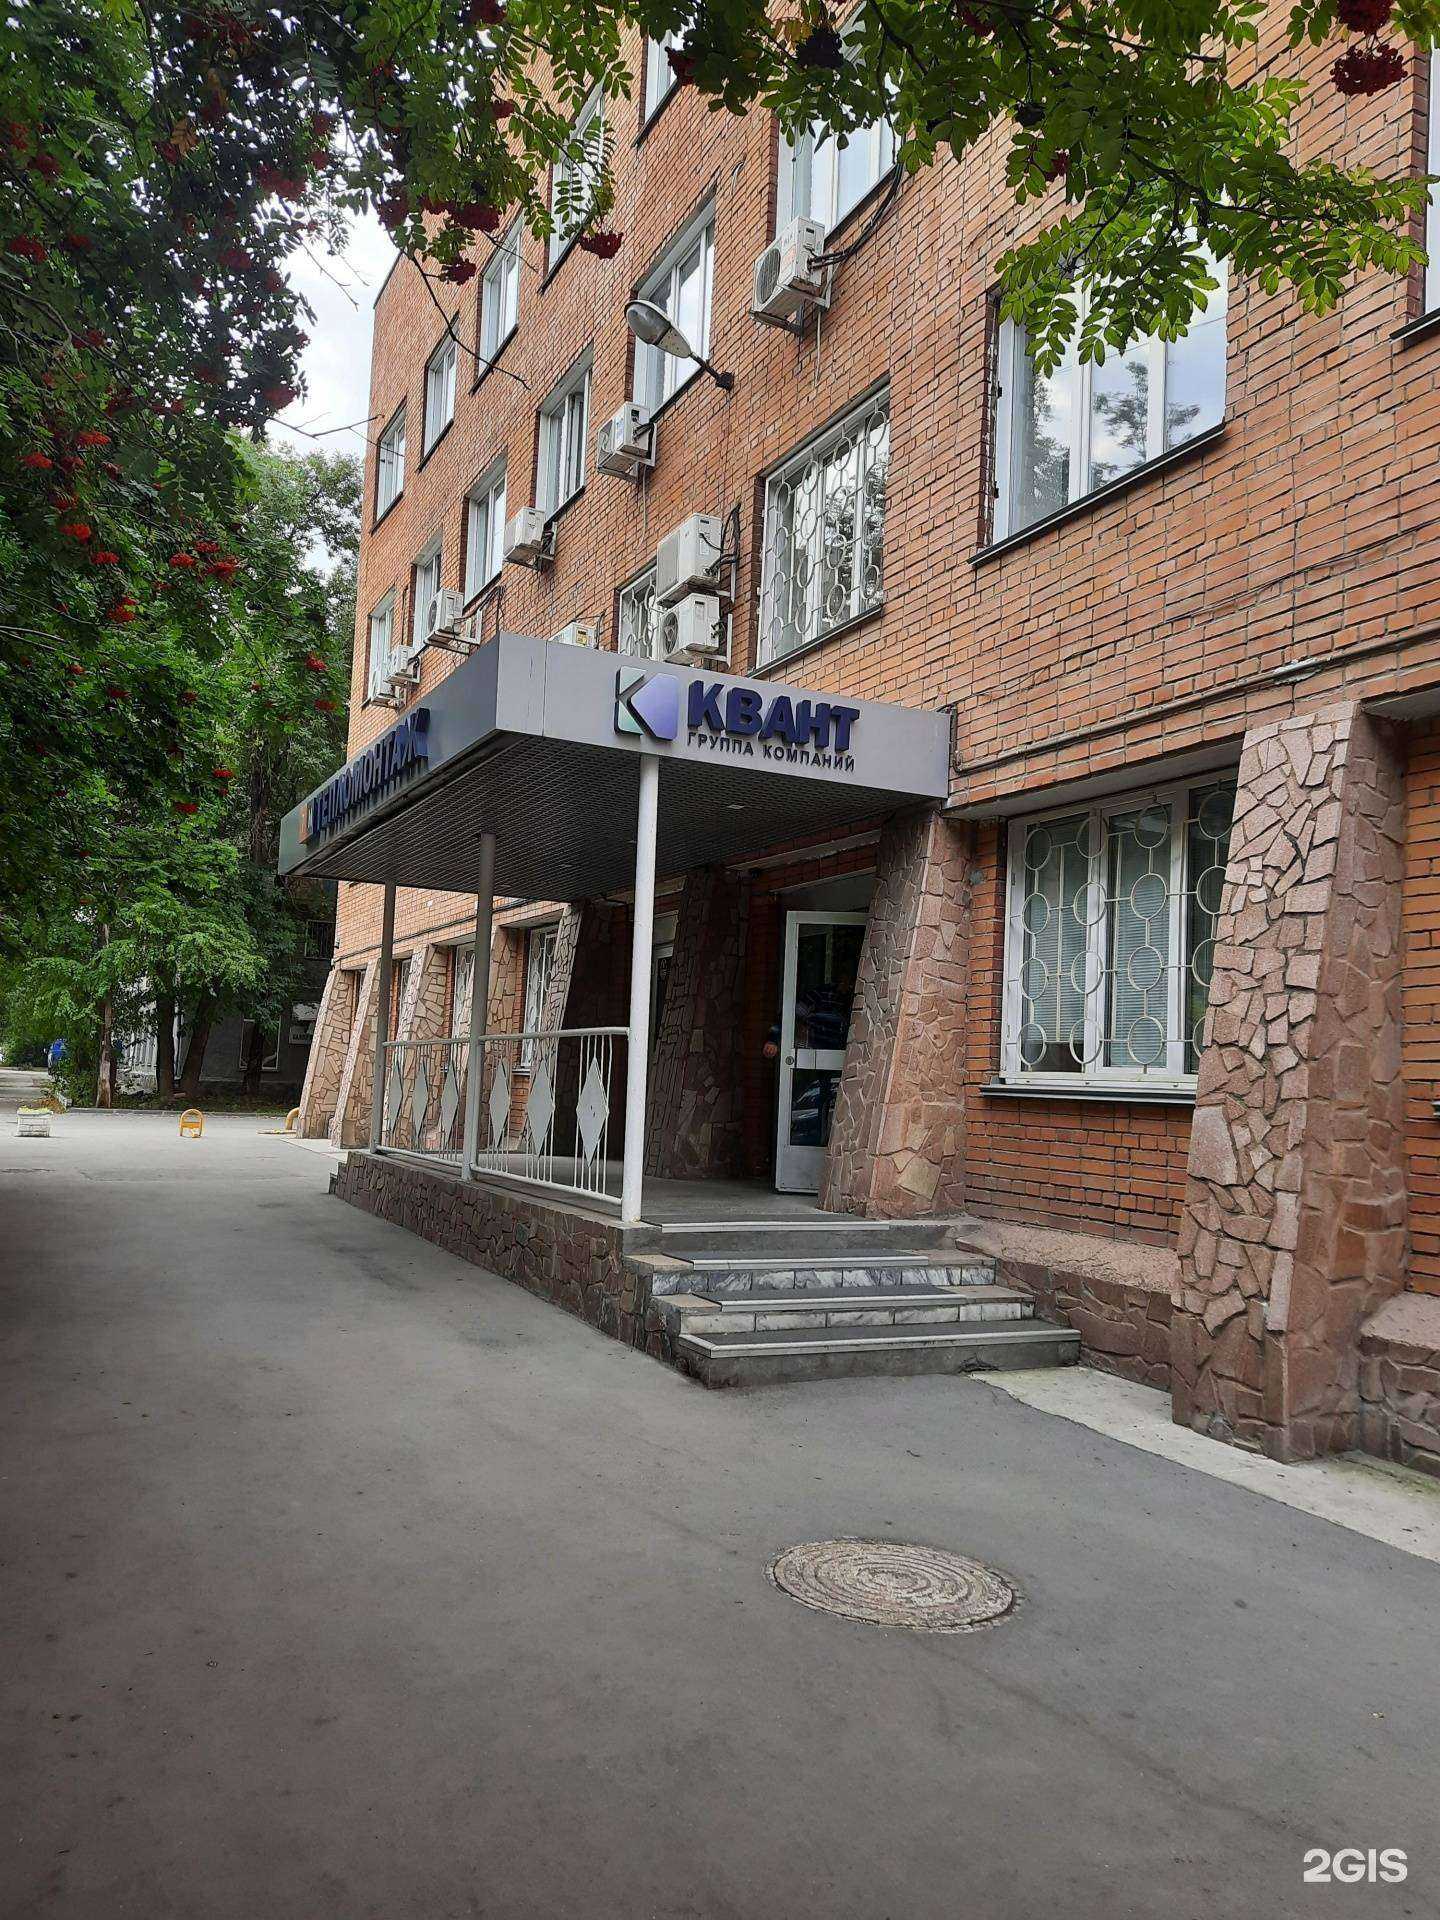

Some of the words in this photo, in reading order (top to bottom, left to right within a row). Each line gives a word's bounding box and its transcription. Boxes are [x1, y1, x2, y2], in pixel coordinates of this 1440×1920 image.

[688, 680, 860, 752] КВАНТ
[687, 732, 754, 757] ГРУППА
[763, 744, 855, 772] КОМПАНИЙ
